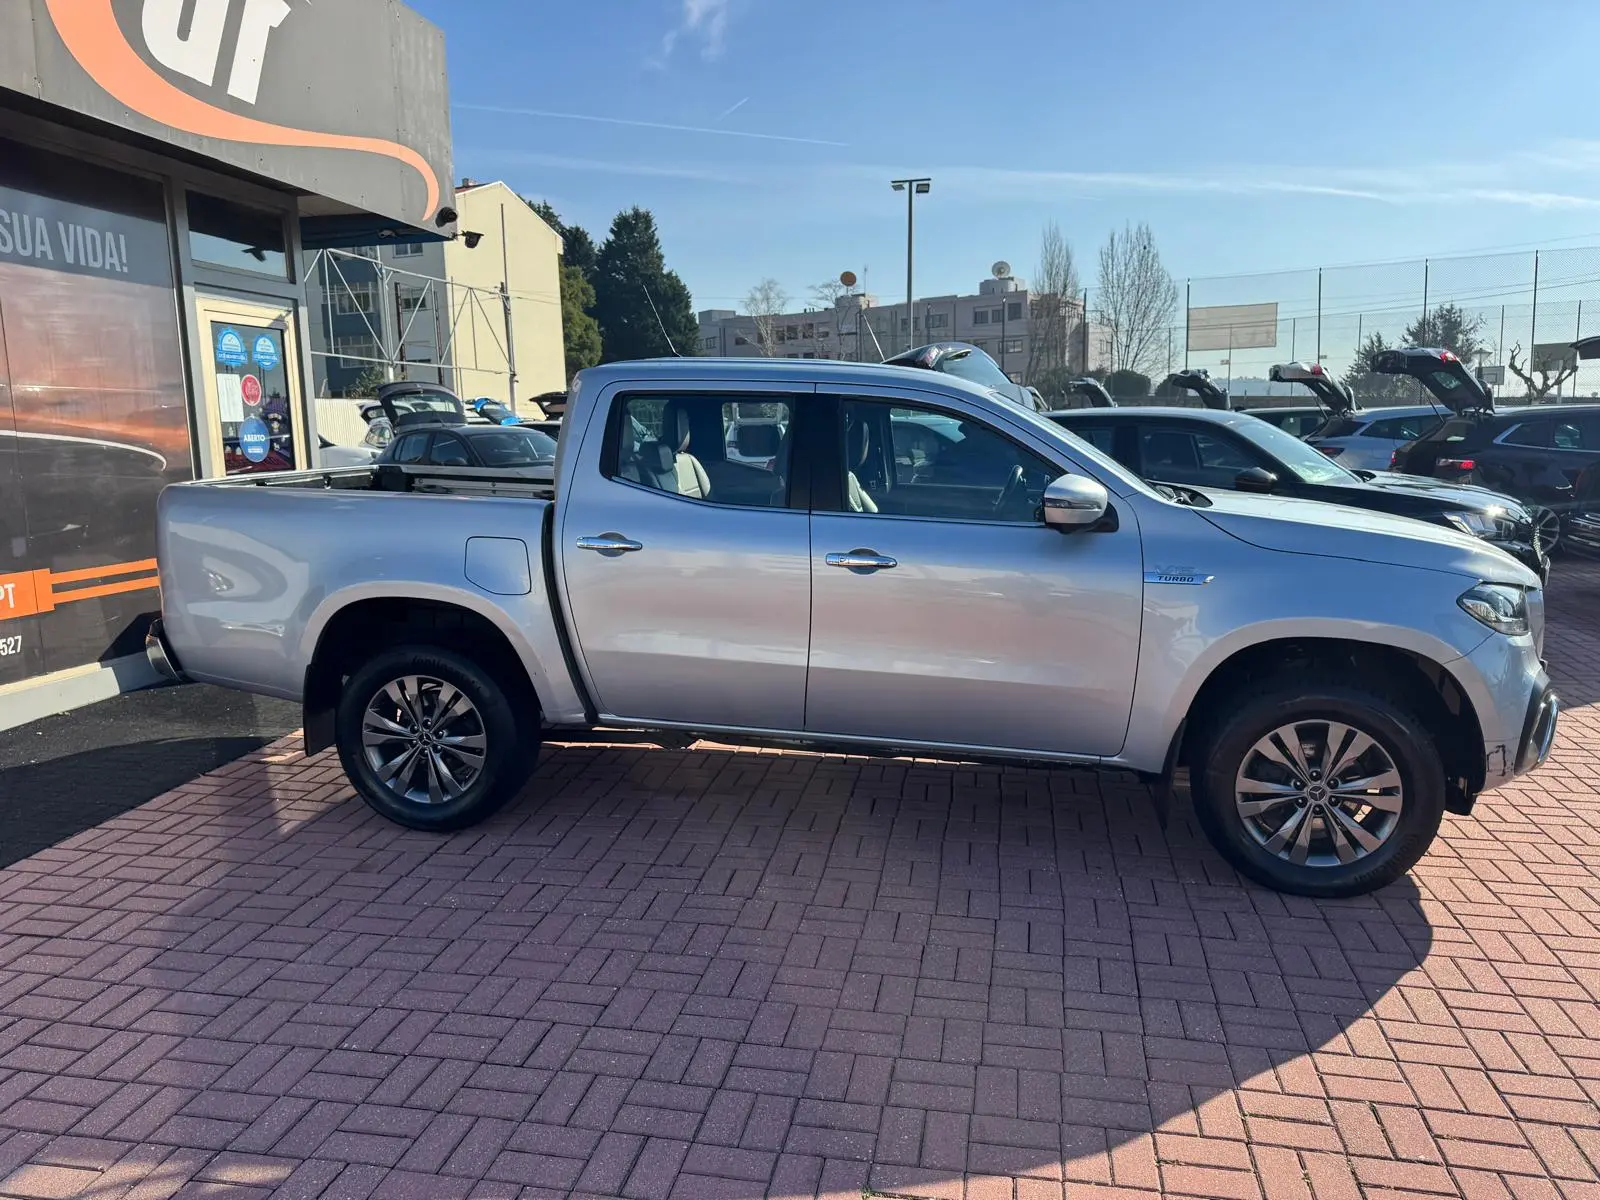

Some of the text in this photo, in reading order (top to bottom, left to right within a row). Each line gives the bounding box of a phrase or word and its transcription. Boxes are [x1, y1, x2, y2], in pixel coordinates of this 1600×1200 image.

[0, 209, 129, 273] SUA VIDA!
[243, 434, 266, 442] ABERTO
[1157, 575, 1194, 583] TURBO
[0, 635, 22, 656] 527
